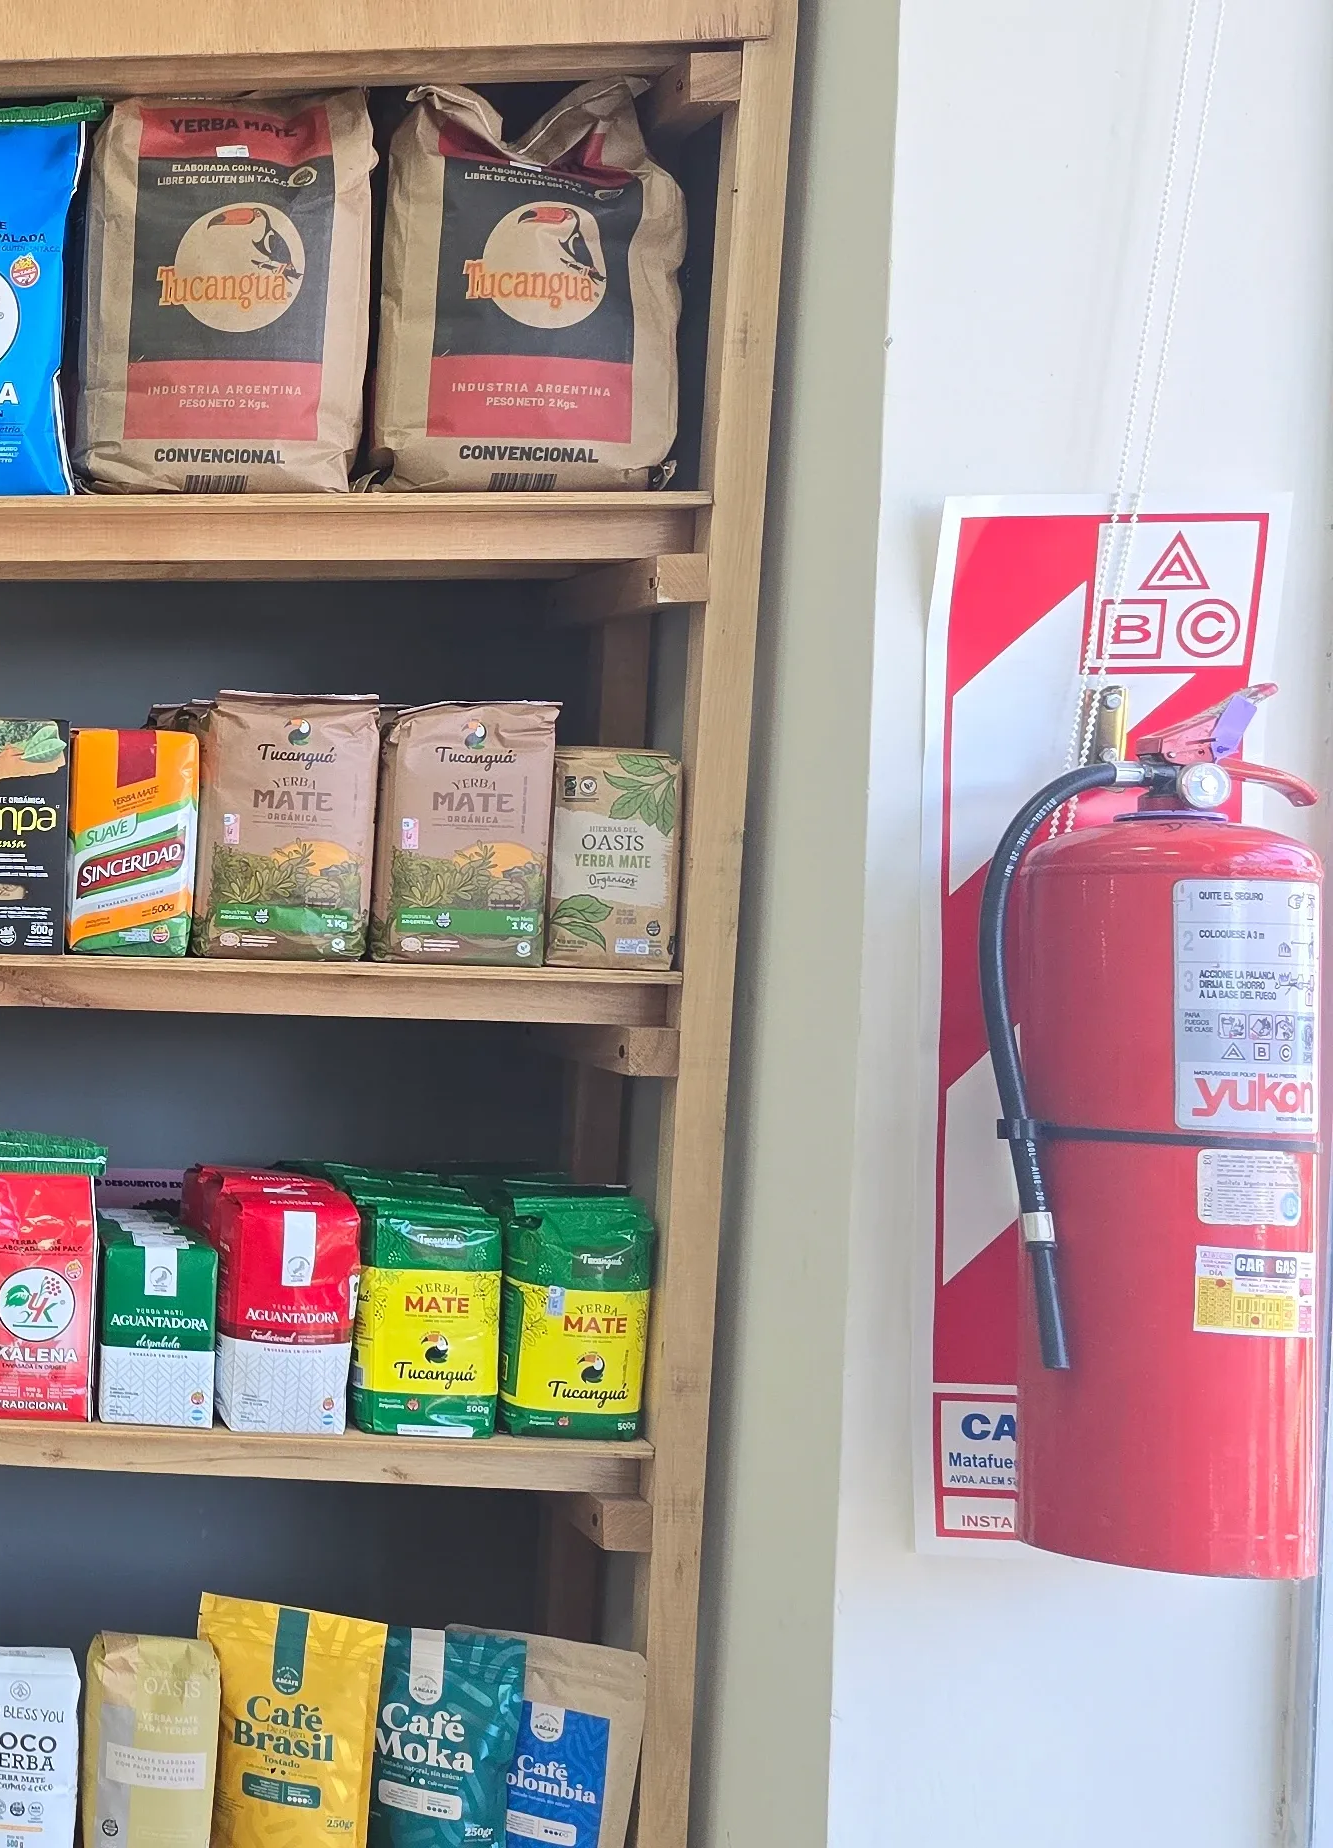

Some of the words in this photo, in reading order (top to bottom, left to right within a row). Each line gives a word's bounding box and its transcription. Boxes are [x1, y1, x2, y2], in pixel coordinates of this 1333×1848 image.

[171, 118, 239, 134] YERBA
[243, 119, 297, 138] MATE
[171, 163, 229, 174] ELABORADA
[232, 164, 249, 174] CON
[251, 166, 277, 176] PALO
[157, 260, 288, 309] Tucanguá
[463, 259, 595, 309] Tucanguá
[147, 383, 219, 396] INDUSTRIA
[225, 384, 303, 396] ARGENTINA
[153, 446, 286, 464] CONVENCIONAL
[459, 445, 599, 464] CONVENCIONAL
[1158, 552, 1194, 581] A
[1114, 614, 1152, 644] B
[1190, 610, 1227, 645] C
[257, 743, 335, 769] Tucanguá
[273, 776, 317, 791] YERBA
[253, 789, 333, 811] MATE
[267, 812, 318, 824] ORGÁNICA
[86, 819, 128, 847] SUAVE
[582, 833, 644, 853] OASIS
[81, 843, 181, 886] SINCERIDAD
[574, 853, 613, 870] YERBA
[616, 853, 651, 870] MATE
[1199, 892, 1222, 900] QUITE
[1224, 892, 1233, 900] EL
[1235, 892, 1263, 901] SEGURO
[152, 903, 174, 915] 500g
[1199, 930, 1245, 939] COLOQUESE
[1247, 930, 1252, 939] A
[1253, 931, 1258, 939] 3
[414, 1282, 460, 1296] YERBA
[405, 1296, 470, 1315] MATE
[110, 1314, 209, 1331] AGUANTADORA
[245, 1307, 339, 1325] AGUANTADORA
[563, 1315, 627, 1335] MATE
[394, 1361, 478, 1389] Tucanguá
[548, 1380, 630, 1409] Tucanguá
[466, 1404, 489, 1415] 500g
[4, 1706, 38, 1720] BLESS
[42, 1709, 64, 1723] YOU
[246, 1695, 323, 1731] Café
[382, 1703, 465, 1743] Café
[233, 1719, 334, 1762] Brasil
[376, 1726, 474, 1774] Moka
[506, 1770, 596, 1804] olombia
[326, 1817, 354, 1831] 250gr
